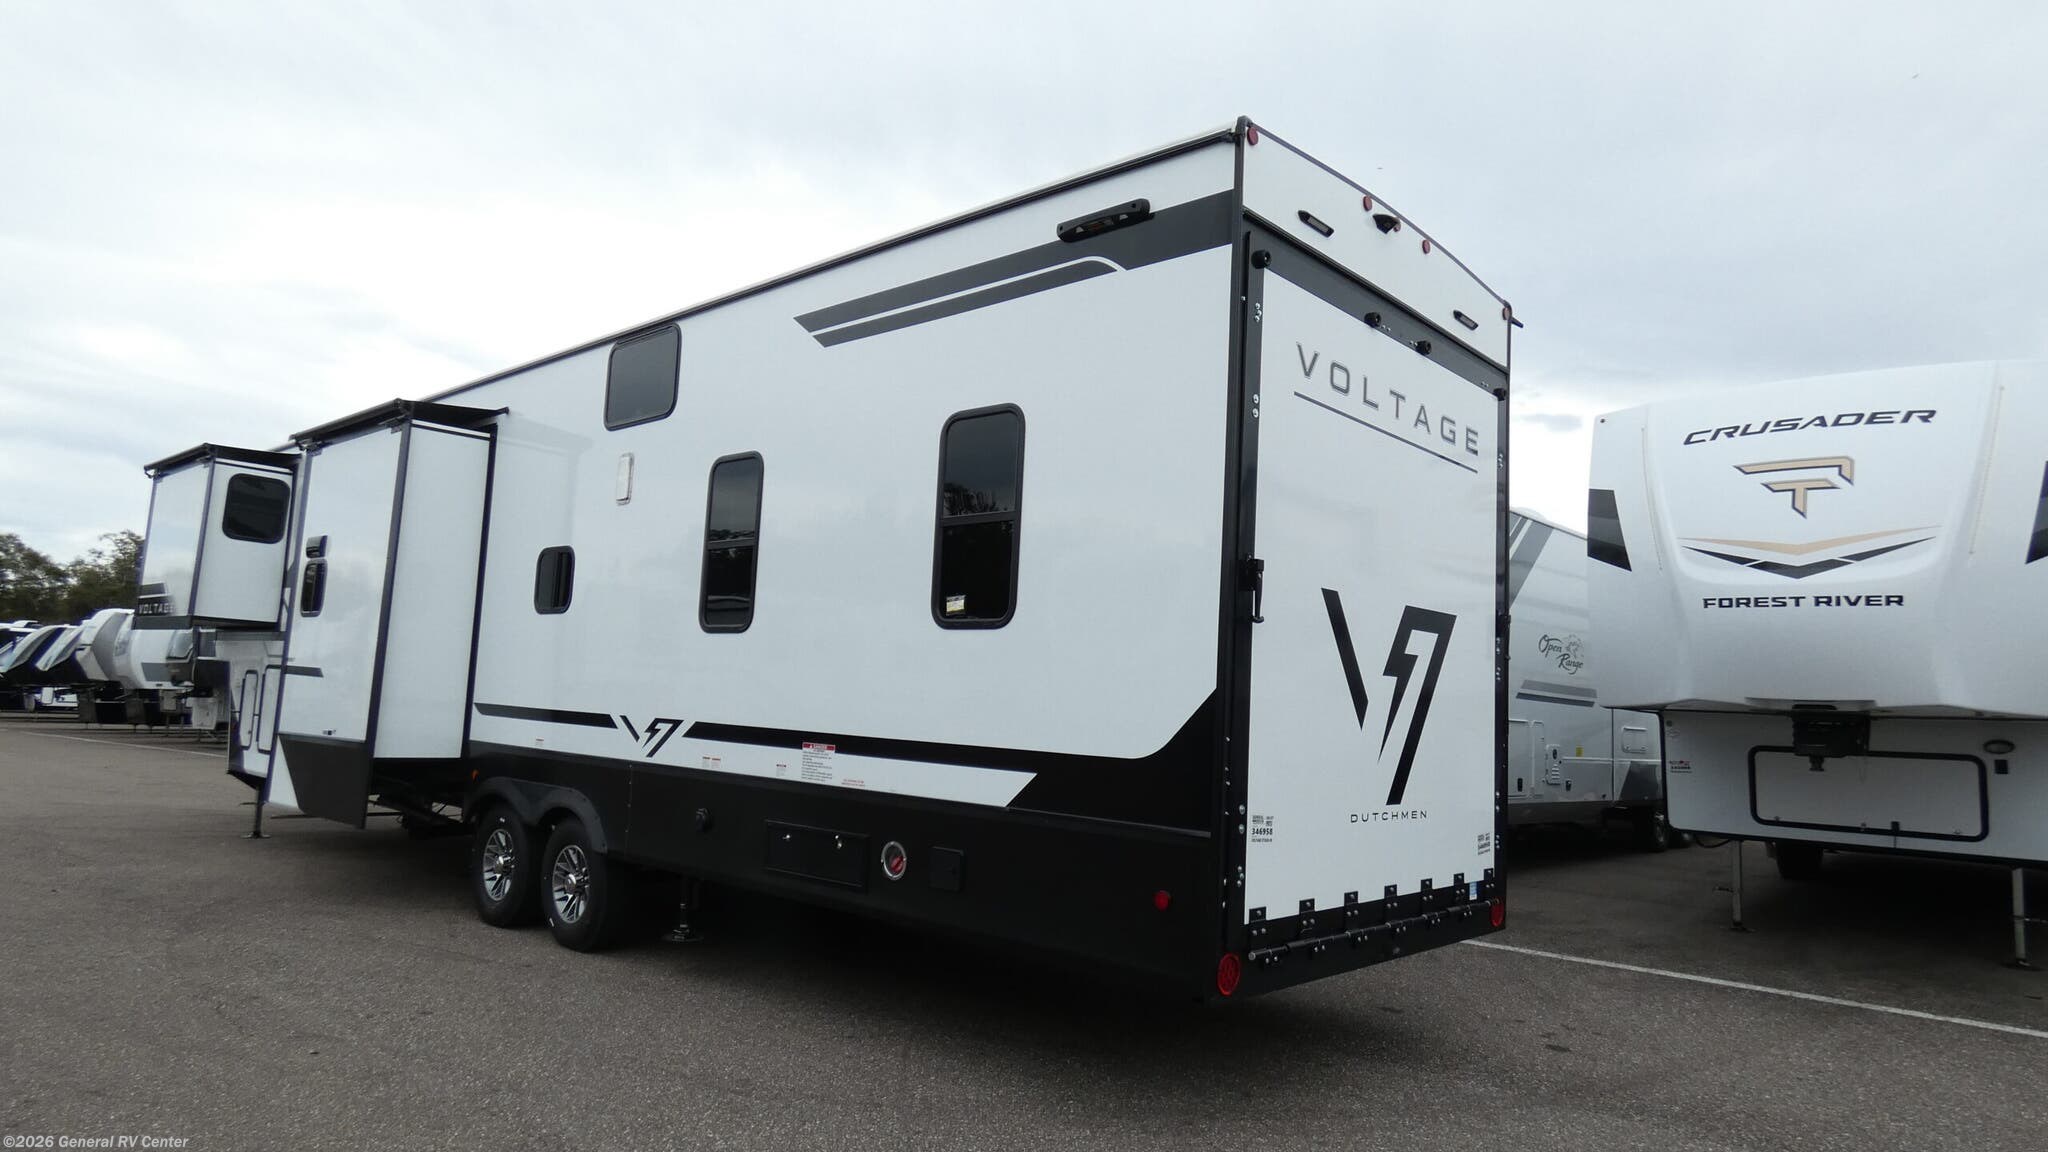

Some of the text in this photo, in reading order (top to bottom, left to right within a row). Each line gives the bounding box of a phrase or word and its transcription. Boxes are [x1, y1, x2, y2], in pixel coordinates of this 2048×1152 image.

[1296, 342, 1480, 456] VOLTAGE
[1683, 409, 1938, 446] CRUSADER
[1702, 594, 1906, 610] FOREST RIVER
[1538, 634, 1563, 659] Open
[1556, 652, 1584, 676] Range
[1349, 809, 1429, 825] DUTCHMEN
